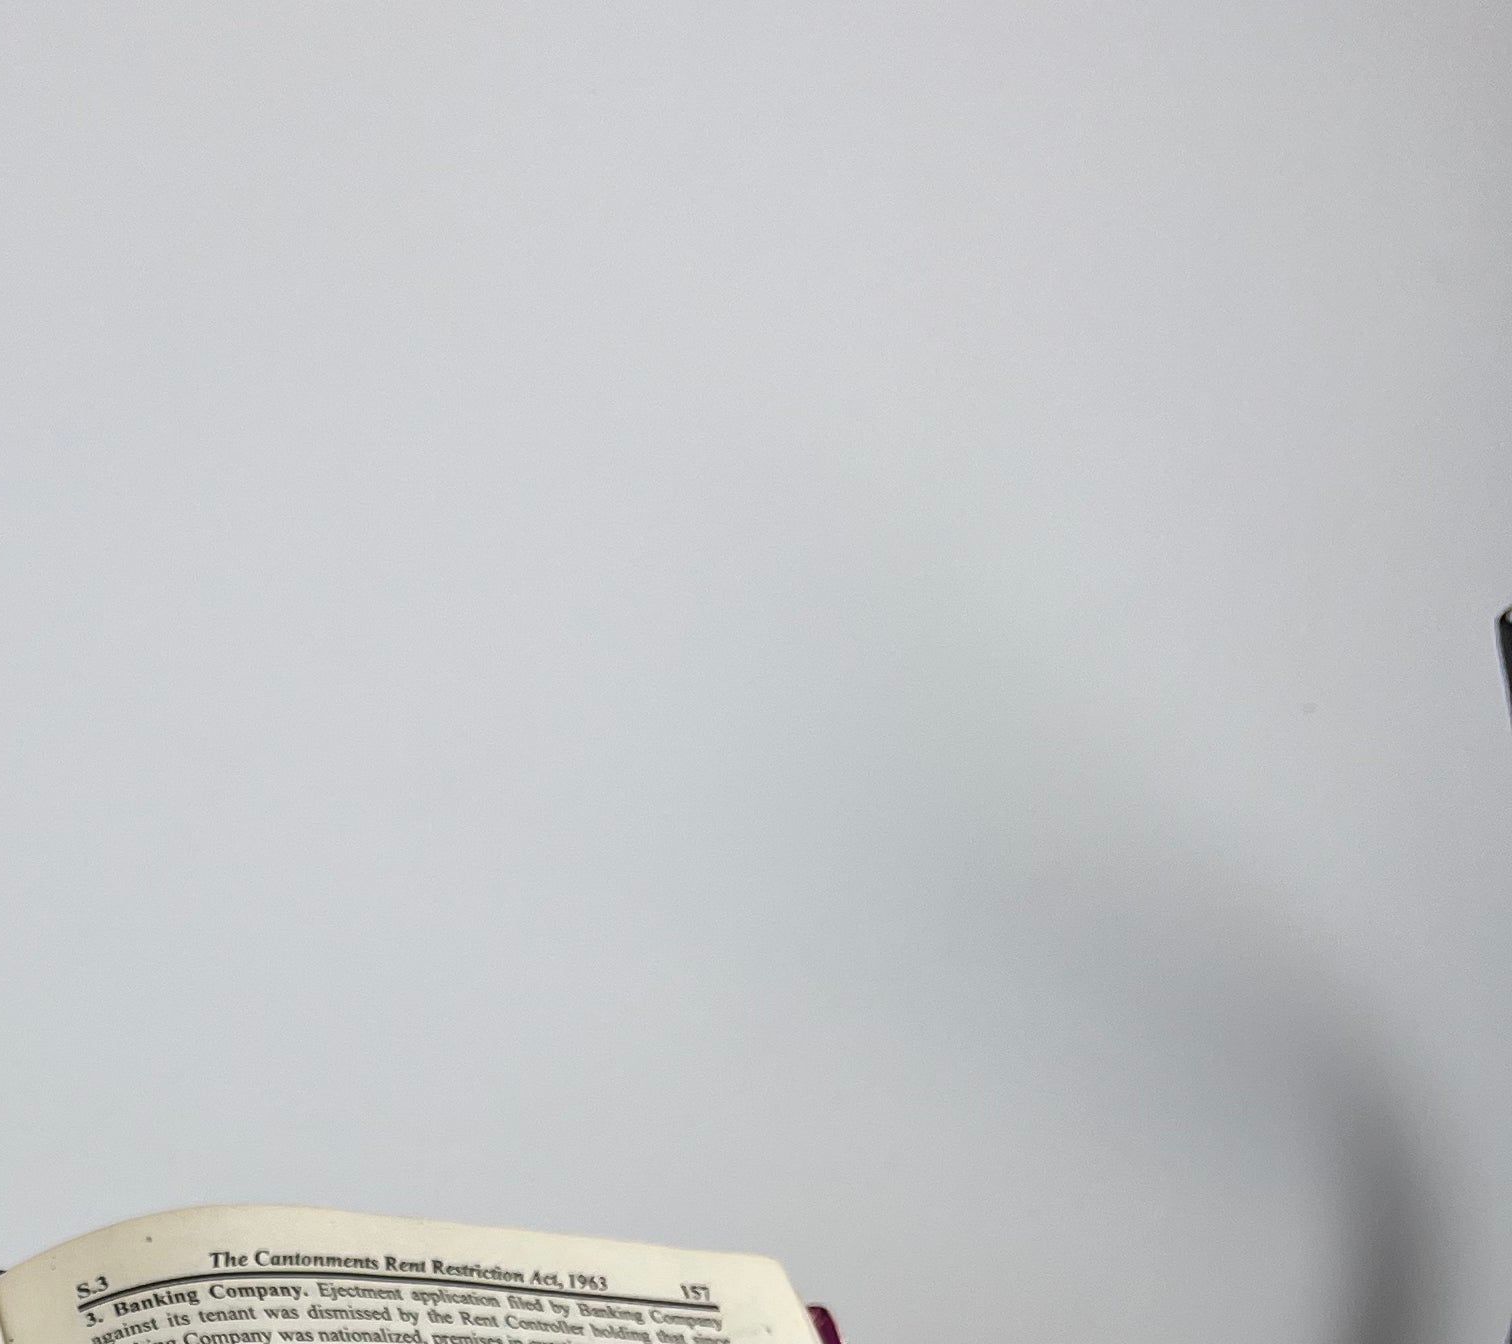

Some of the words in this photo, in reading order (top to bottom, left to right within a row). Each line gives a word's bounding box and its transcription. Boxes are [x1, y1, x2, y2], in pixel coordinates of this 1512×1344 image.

[209, 1252, 248, 1268] The
[255, 1251, 379, 1270] Cantonments
[384, 1256, 426, 1273] Rent
[432, 1260, 524, 1282] Restriction
[530, 1271, 563, 1289] Act,
[569, 1275, 607, 1291] 1963
[77, 1276, 108, 1299] S.3
[681, 1285, 709, 1301] 157
[86, 1312, 103, 1327] 3.
[113, 1291, 200, 1317] Banking
[209, 1284, 308, 1301] Company.
[317, 1283, 403, 1302] Ejectment
[412, 1289, 500, 1307] application
[507, 1295, 544, 1312] filed
[549, 1300, 569, 1318] by
[577, 1303, 645, 1325] Banking
[650, 1310, 721, 1331] Company
